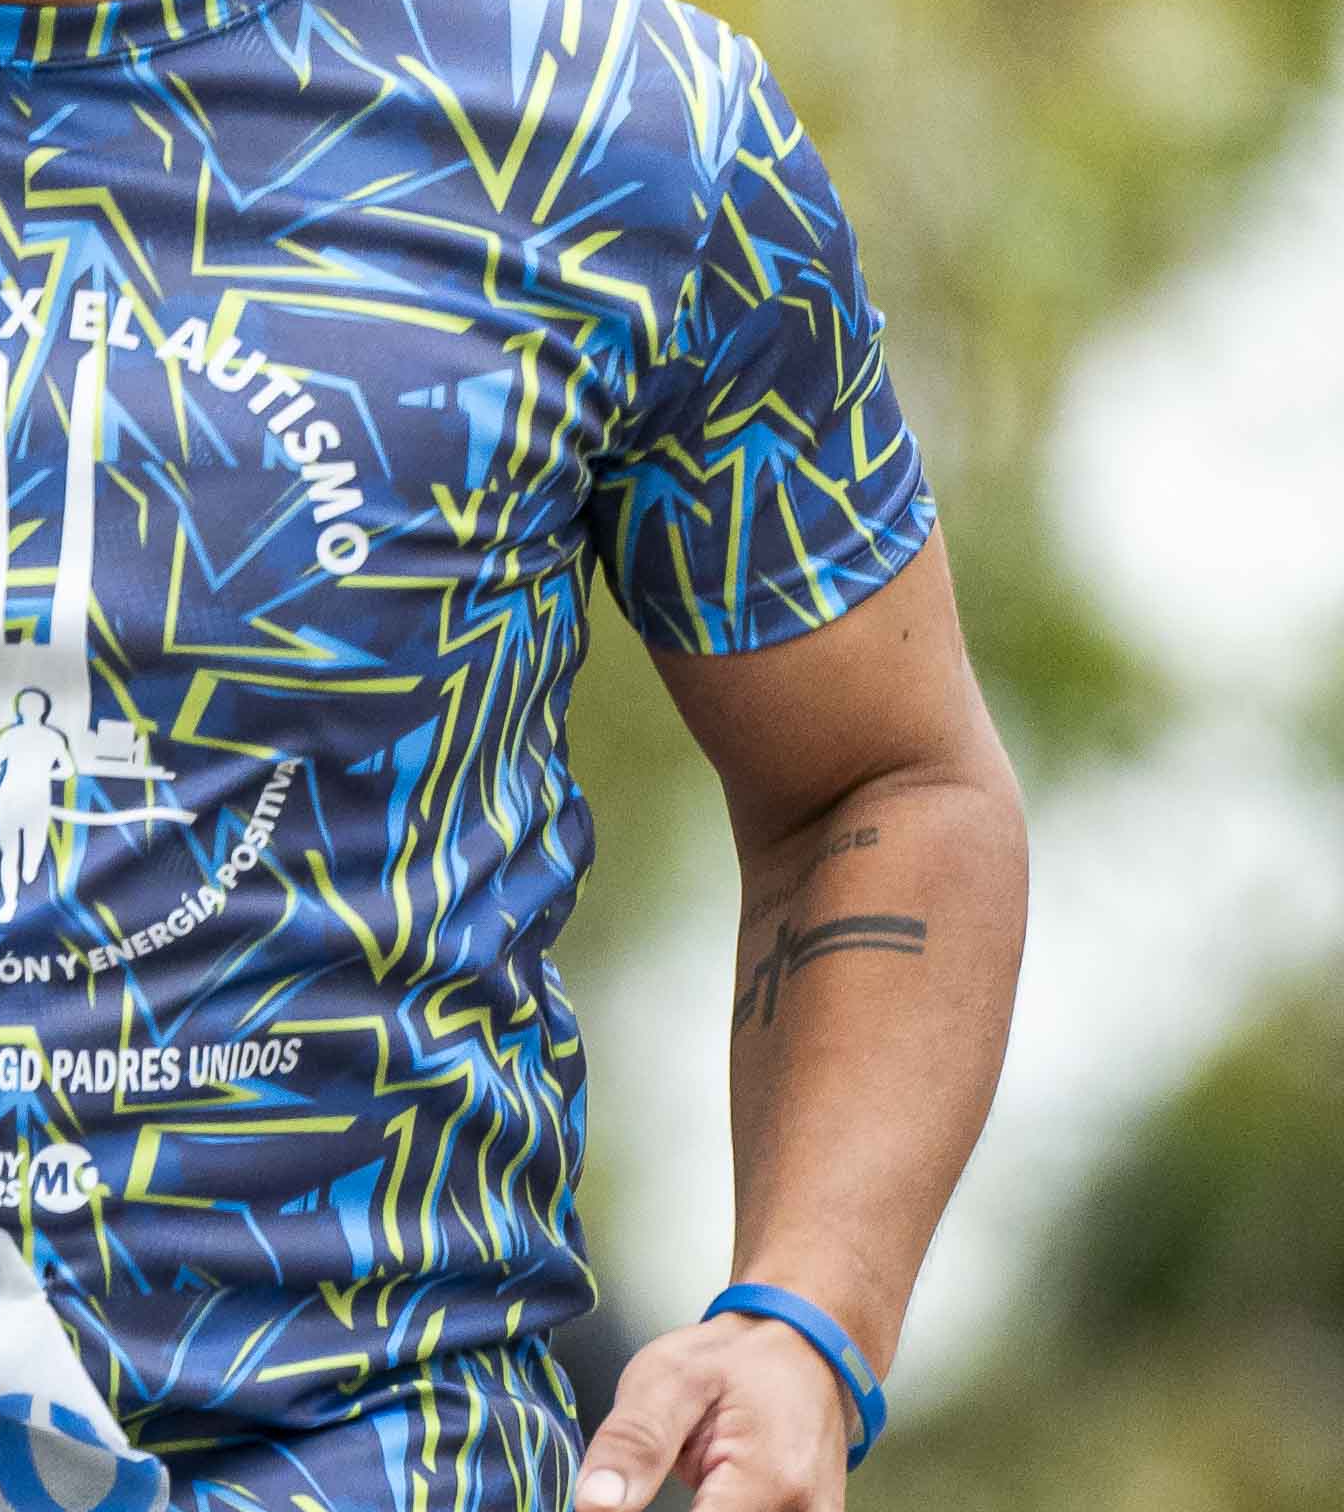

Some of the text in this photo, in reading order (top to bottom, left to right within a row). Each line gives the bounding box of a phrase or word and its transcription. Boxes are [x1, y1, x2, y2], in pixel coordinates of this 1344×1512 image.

[69, 290, 141, 352] EL
[154, 317, 370, 576] AUTISMO
[56, 953, 79, 982] Y
[88, 884, 227, 974] ENERGÍA
[215, 757, 305, 890] POSITIVA
[51, 1047, 181, 1094] PADRES
[188, 1036, 303, 1087] UNIDOS
